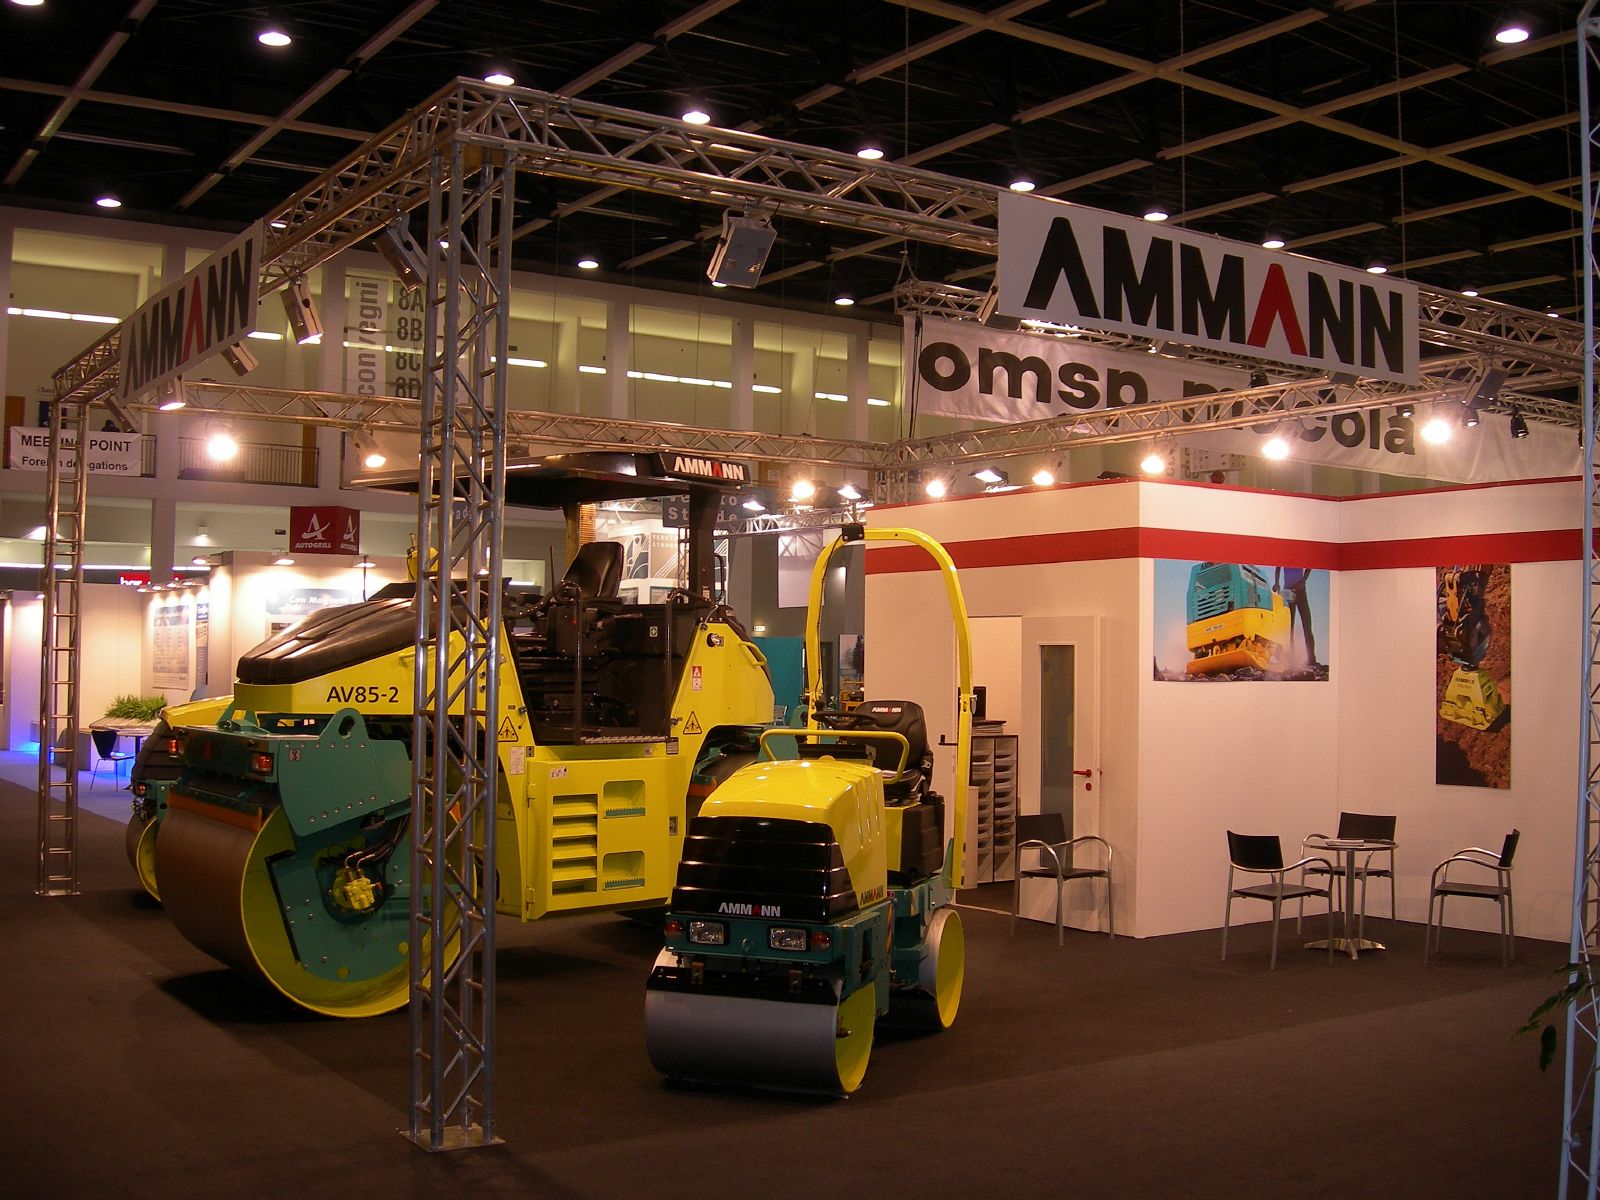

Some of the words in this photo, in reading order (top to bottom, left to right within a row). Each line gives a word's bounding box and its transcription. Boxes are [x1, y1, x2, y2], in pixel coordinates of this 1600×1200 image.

[397, 287, 424, 313] 8A
[1023, 216, 1404, 374] AMMANN
[122, 238, 253, 399] AMMANN
[396, 316, 423, 342] 8B
[21, 435, 79, 449] MEEIN
[89, 439, 132, 452] POINT
[21, 456, 63, 467] Forein
[673, 456, 745, 481] AMMANN
[294, 541, 332, 550] AUTOGRILL
[326, 685, 400, 704] AV85-2
[718, 902, 781, 917] AMMANN
